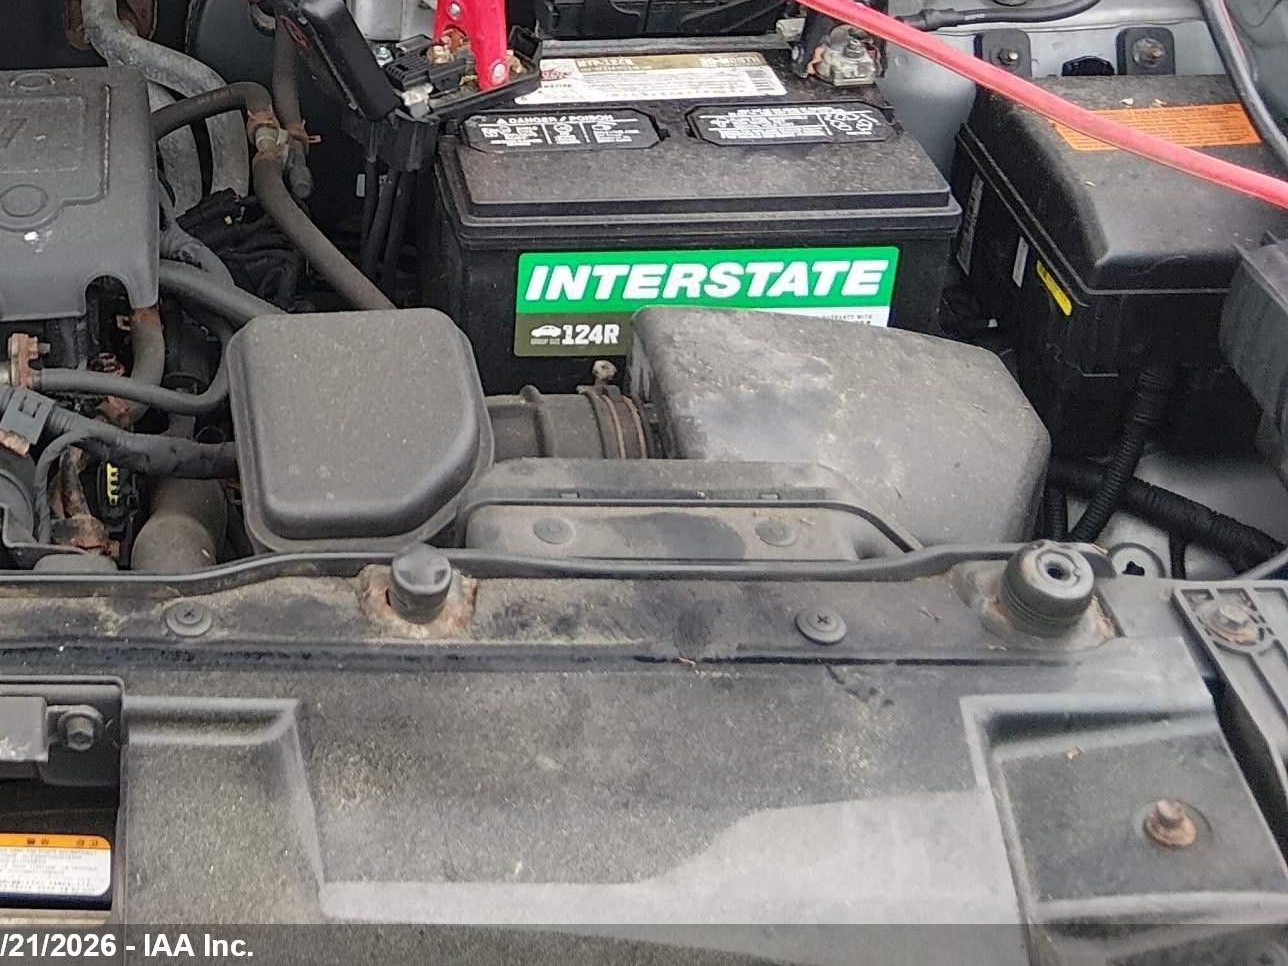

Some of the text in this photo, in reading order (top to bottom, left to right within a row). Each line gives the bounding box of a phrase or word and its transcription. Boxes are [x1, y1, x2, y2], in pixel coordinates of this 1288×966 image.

[508, 116, 558, 124] DANGER
[525, 260, 889, 301] INTERSTATE
[562, 324, 620, 345] 124R
